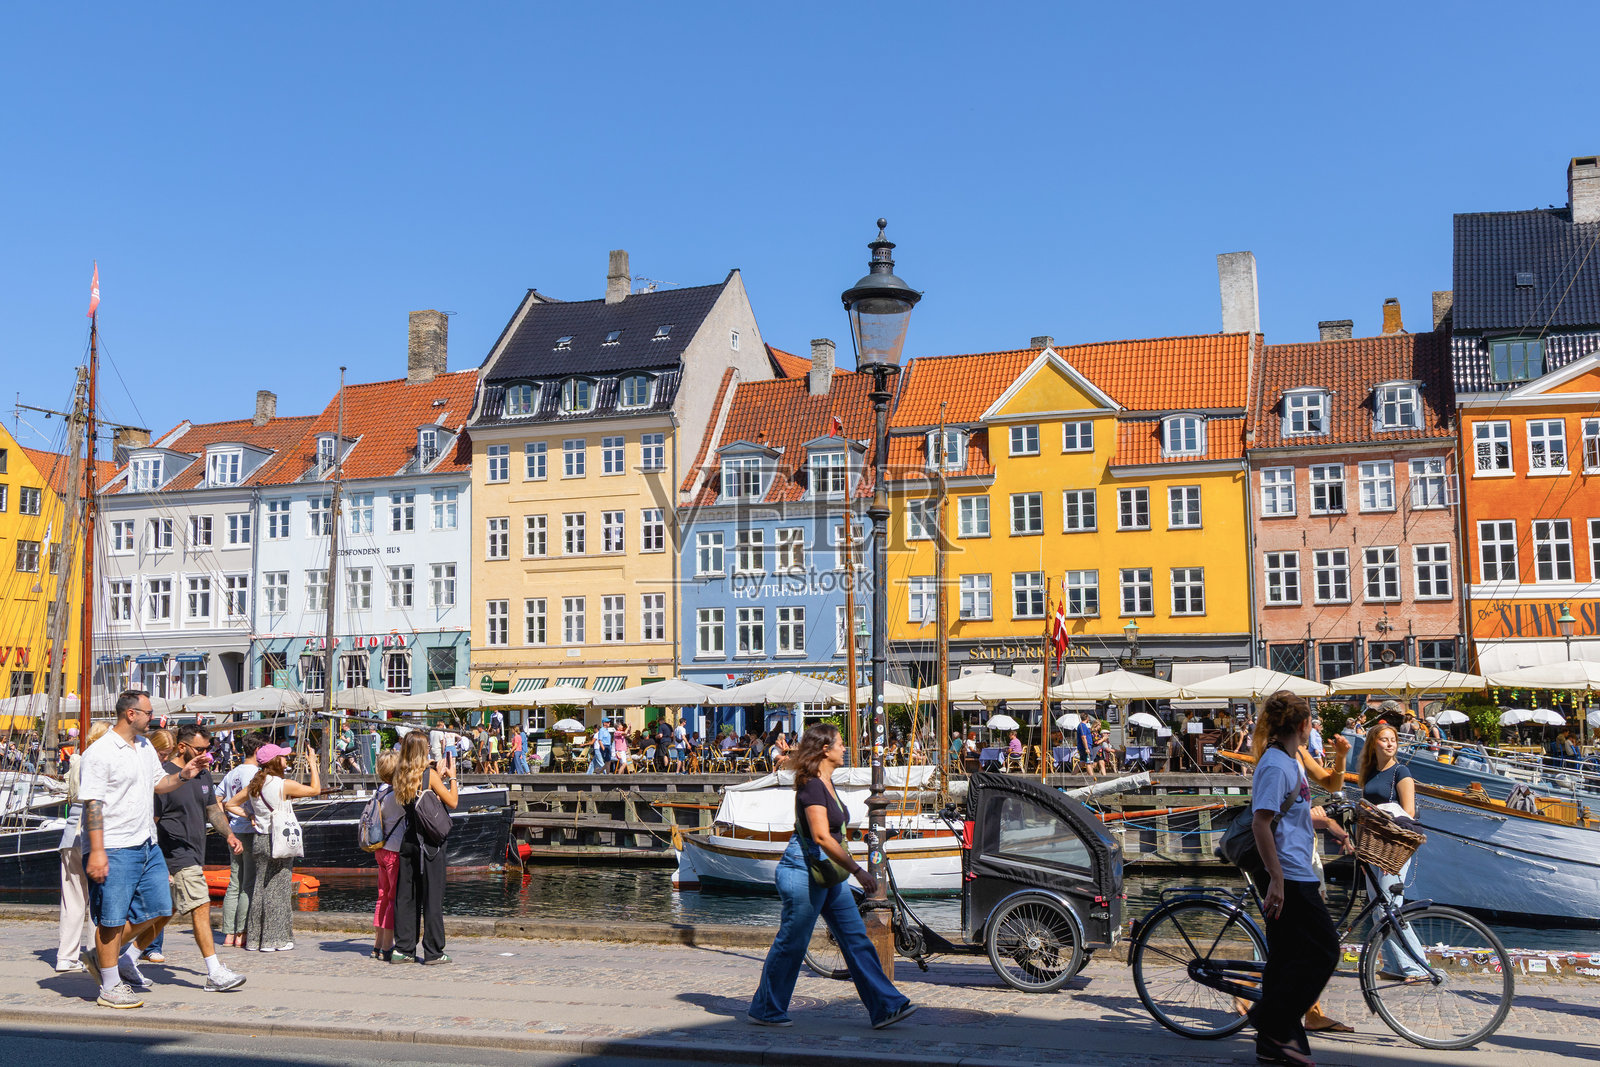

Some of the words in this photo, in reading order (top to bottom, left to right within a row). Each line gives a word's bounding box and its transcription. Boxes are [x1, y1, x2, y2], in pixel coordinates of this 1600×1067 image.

[328, 547, 380, 556] EDSFONDENS
[734, 582, 826, 599] HYTTEFADET
[354, 635, 407, 648] HORN
